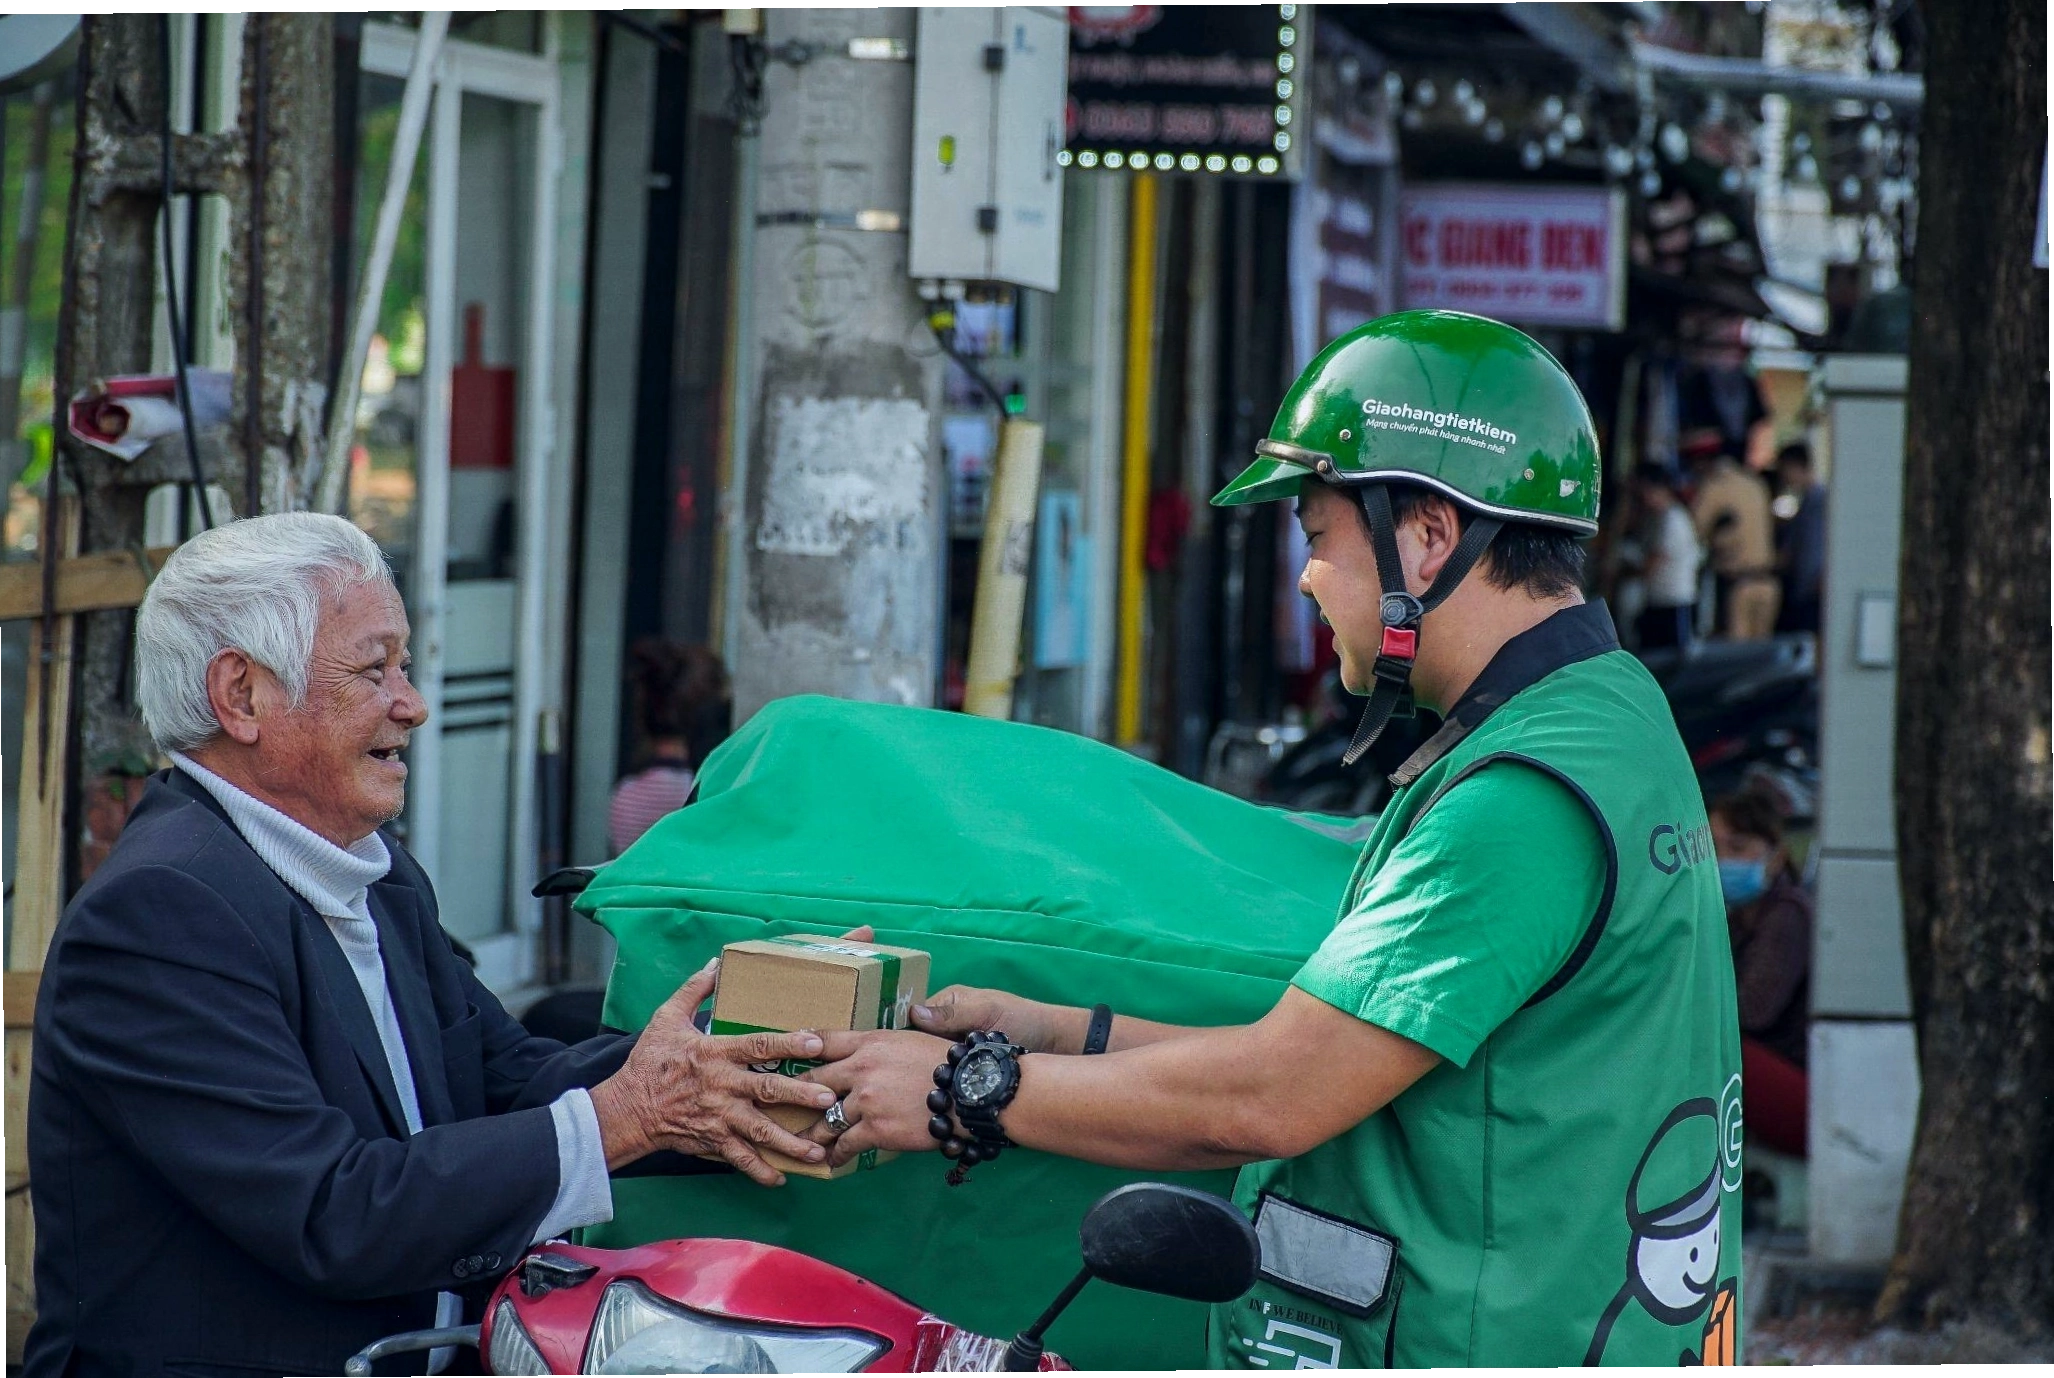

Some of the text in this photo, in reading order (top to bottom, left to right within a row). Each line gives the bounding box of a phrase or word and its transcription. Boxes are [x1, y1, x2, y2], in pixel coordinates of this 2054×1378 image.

[1362, 399, 1517, 445] Giaohangtietkiem
[1460, 435, 1487, 449] nhanh
[1273, 1304, 1294, 1320] WE
[1296, 1310, 1344, 1336] BELIEVE
